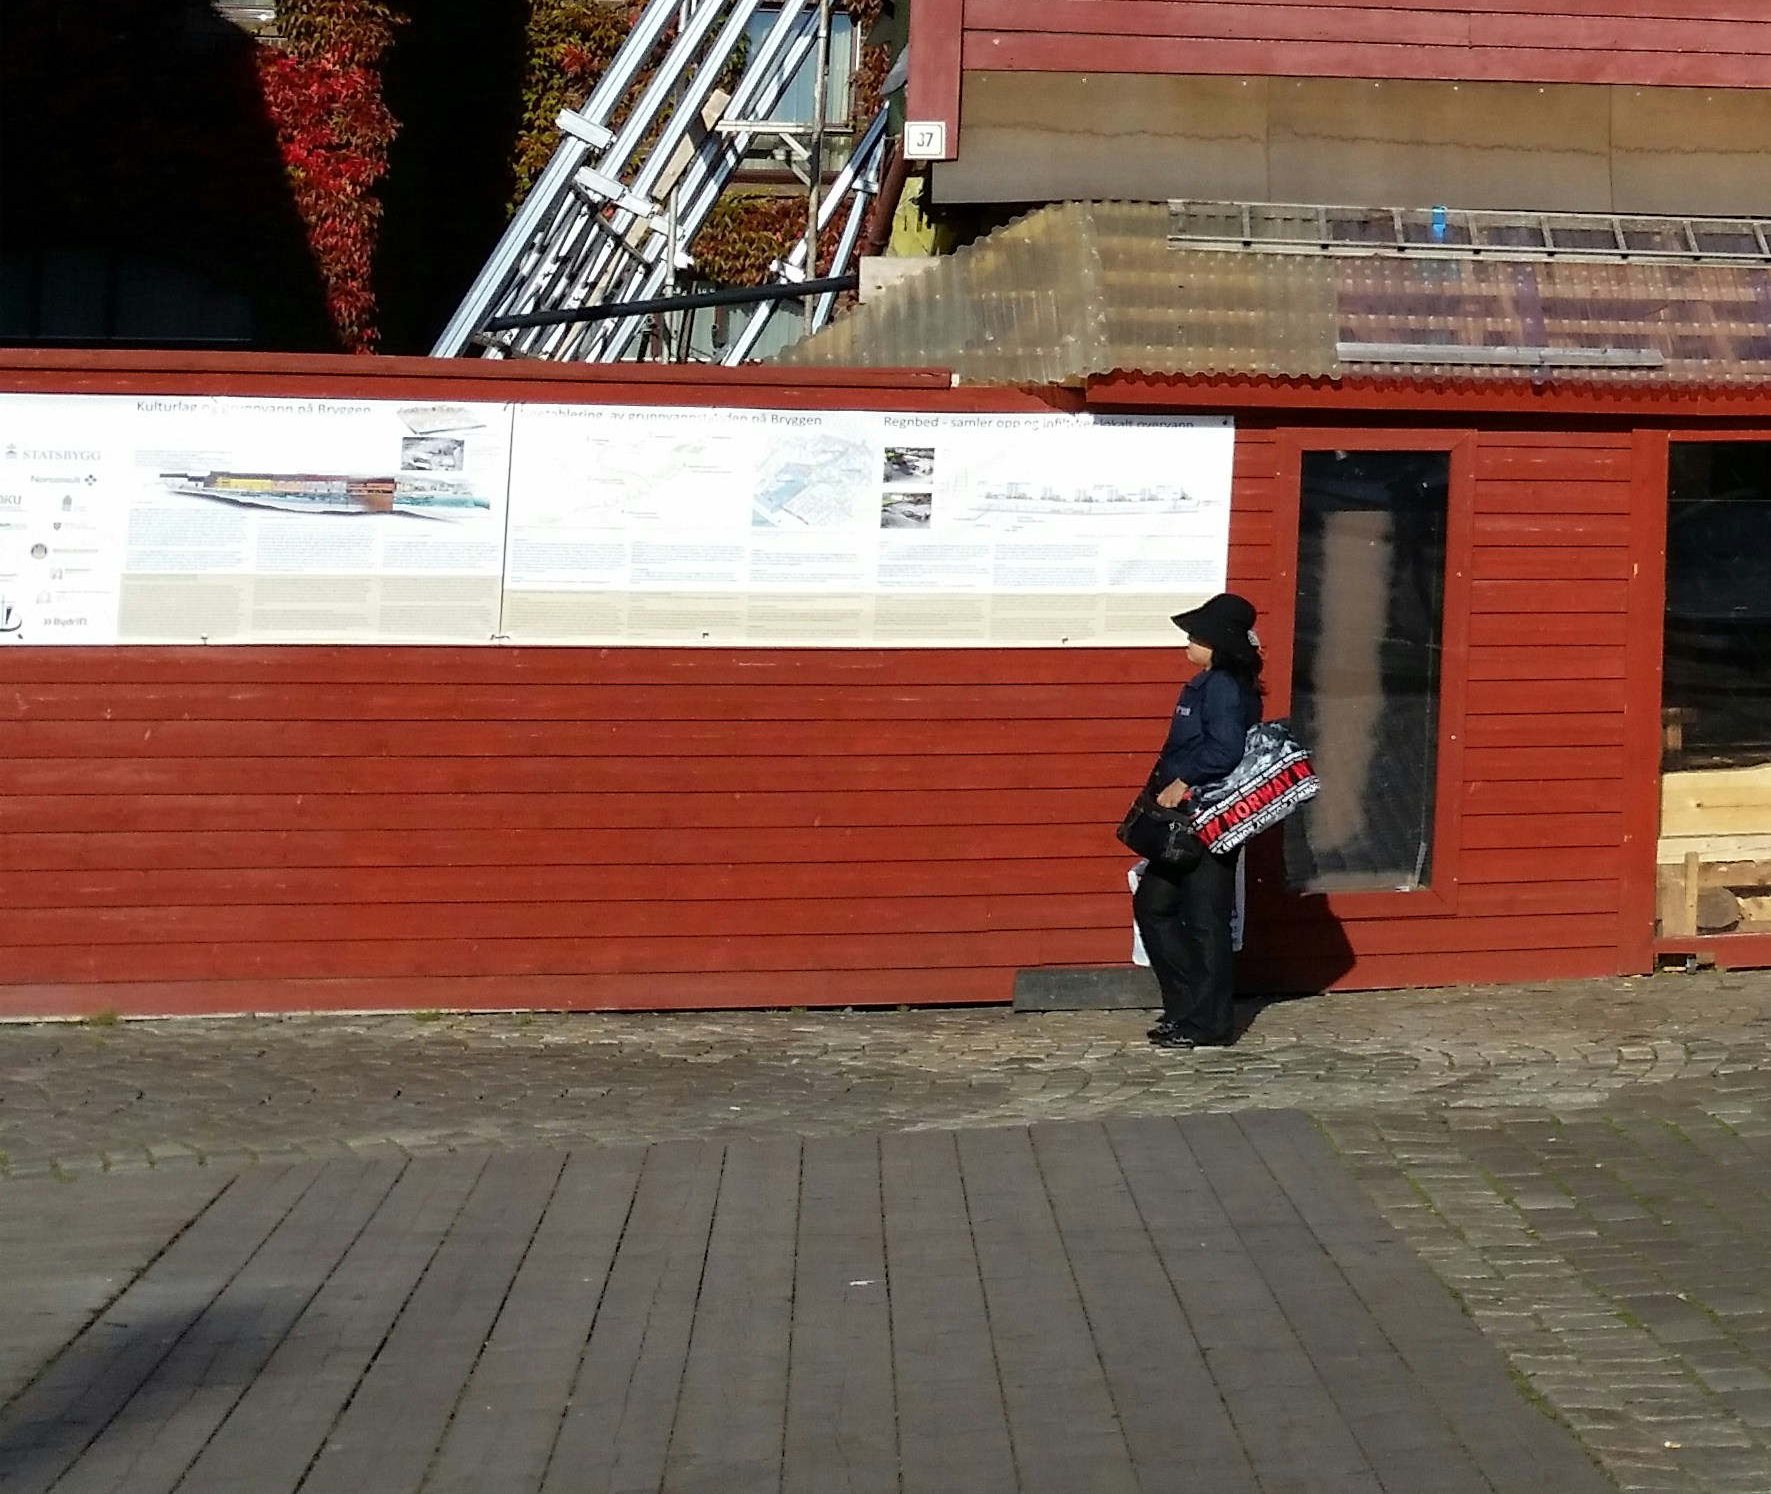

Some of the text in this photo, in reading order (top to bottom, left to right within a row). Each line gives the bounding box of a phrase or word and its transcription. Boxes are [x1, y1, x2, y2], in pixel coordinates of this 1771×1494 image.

[916, 132, 934, 148] 37
[136, 400, 197, 414] Kulturlag
[317, 404, 371, 417] Bryggen
[628, 410, 748, 424] grunnvannstden
[771, 414, 823, 427] Bryggen
[883, 416, 939, 429] Regnbed
[951, 417, 992, 429] samler
[22, 449, 102, 461] STATSBYGG
[30, 475, 81, 485] Norconsult
[53, 617, 88, 628] Bydrift
[1222, 769, 1295, 829] NORWAY
